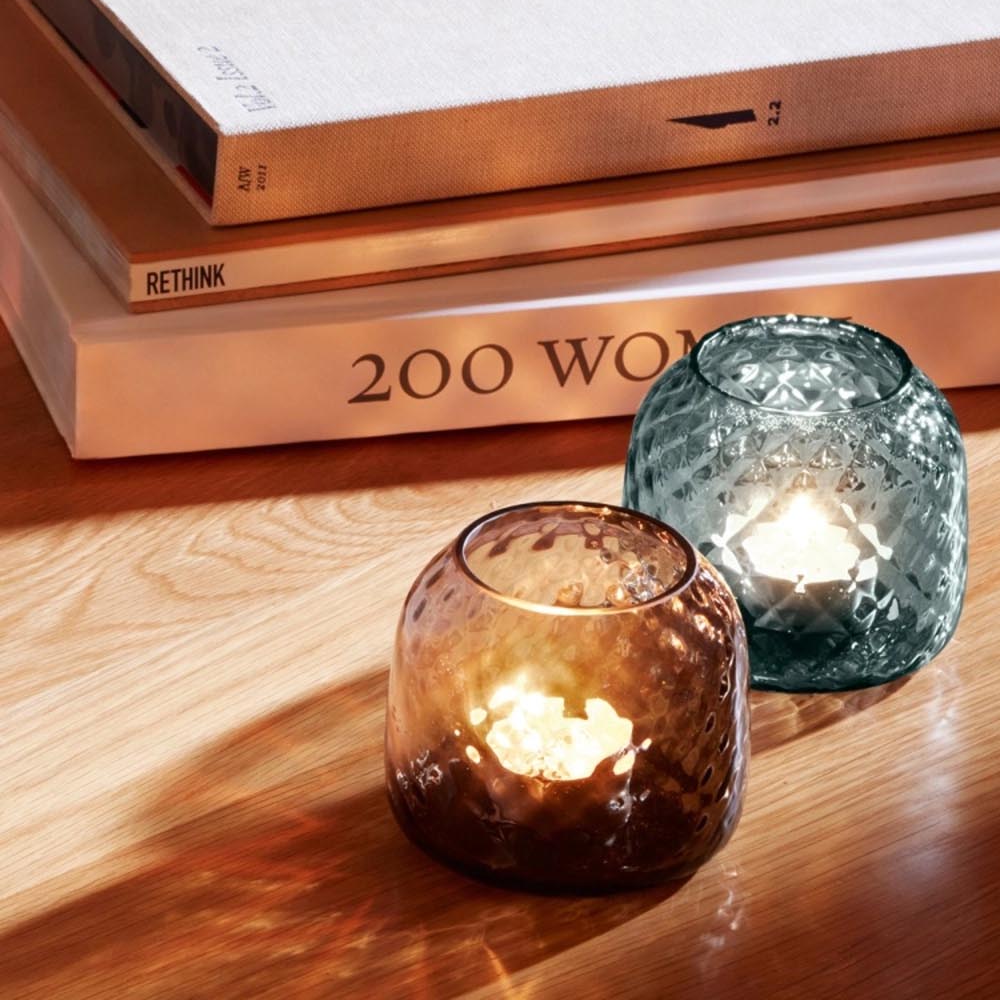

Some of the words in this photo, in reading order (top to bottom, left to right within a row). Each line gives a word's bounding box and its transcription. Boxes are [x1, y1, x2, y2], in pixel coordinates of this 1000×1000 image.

[767, 99, 782, 126] 2.2
[146, 263, 226, 296] RETHINK
[348, 343, 514, 404] 200
[537, 329, 700, 388] WO
